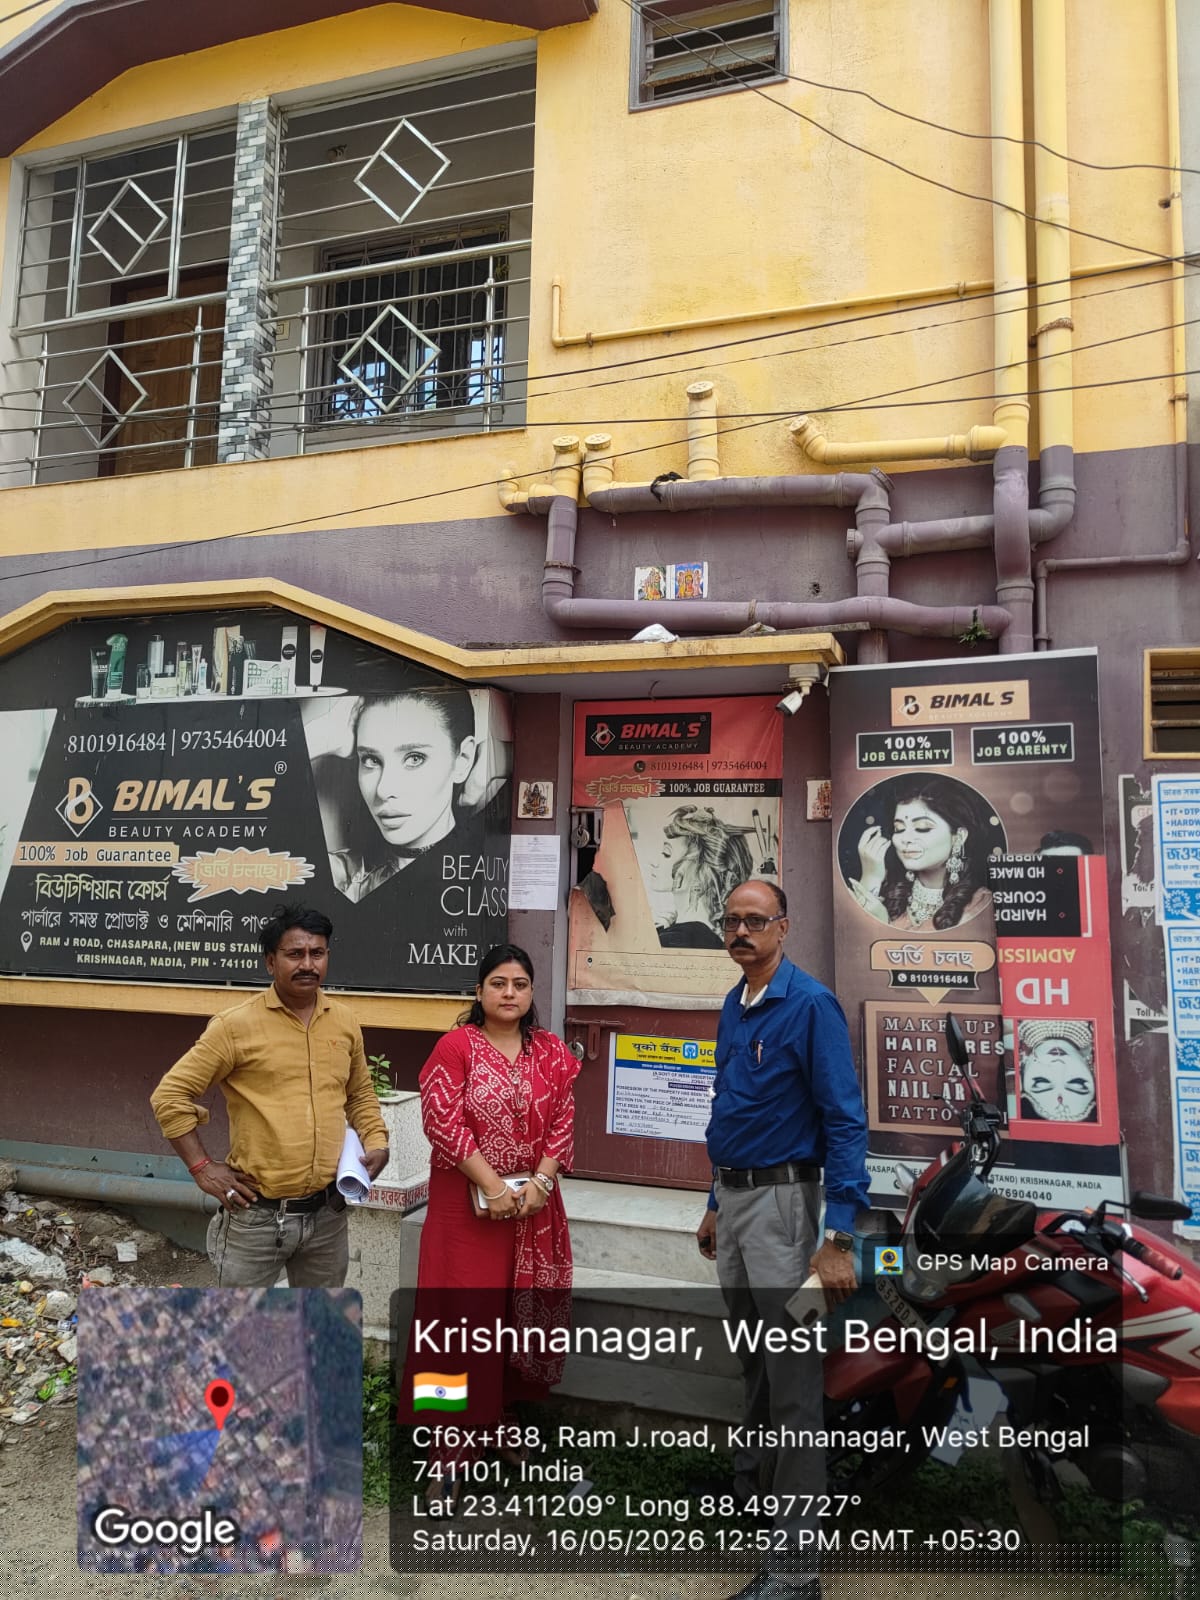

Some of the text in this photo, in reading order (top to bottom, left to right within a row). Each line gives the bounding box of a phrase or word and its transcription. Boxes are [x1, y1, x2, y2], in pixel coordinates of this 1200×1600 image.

[620, 722, 702, 739] BIMAL'S
[998, 730, 1047, 745] 100%
[67, 728, 287, 753] 8101916484 9735464004
[884, 736, 931, 750] 100%
[861, 749, 950, 762] JOB GARENTY
[976, 743, 1068, 758] JOB GARENTY
[651, 761, 768, 771] 8101916484 9735464004
[112, 776, 277, 812] BIMAL'S
[669, 783, 765, 793] 100% JOB GUARANTEE
[109, 825, 268, 838] BEAUTY ACADEMY
[19, 845, 172, 863] 100% Job Guarantee
[442, 855, 509, 882] BEAUTY
[990, 867, 1045, 879] HD MAKE
[35, 873, 170, 905] বিউটিশিয়ান কোর্স
[441, 885, 508, 917] CLASS
[21, 906, 62, 928] পার্লারে
[69, 911, 98, 929] সমস্ত
[157, 914, 169, 929] ও
[177, 908, 234, 933] মেশিনারি
[241, 914, 277, 934] পাও
[443, 923, 468, 937] with
[40, 937, 264, 953] RAM J ROAD, CHASAPARA, (NEW BUS STAN
[77, 953, 147, 968] KRISHNAGAR,
[150, 956, 186, 969] NADIA,
[190, 957, 209, 967] PIN
[220, 958, 258, 969] 741101
[887, 944, 925, 966] ভর্তি
[910, 974, 969, 985] 8101916484
[1016, 978, 1070, 1006] HD
[964, 1020, 996, 1034] UP
[632, 1042, 656, 1052] यूको
[700, 1048, 715, 1057] UC
[886, 1037, 1005, 1055] HAIR RES
[886, 1058, 978, 1077] FACIAL
[888, 1079, 966, 1101] NAIL AR
[1020, 1177, 1075, 1189] KRISHNAGAR,
[1077, 1181, 1102, 1190] NADIA
[988, 1188, 1053, 1201] 076904040
